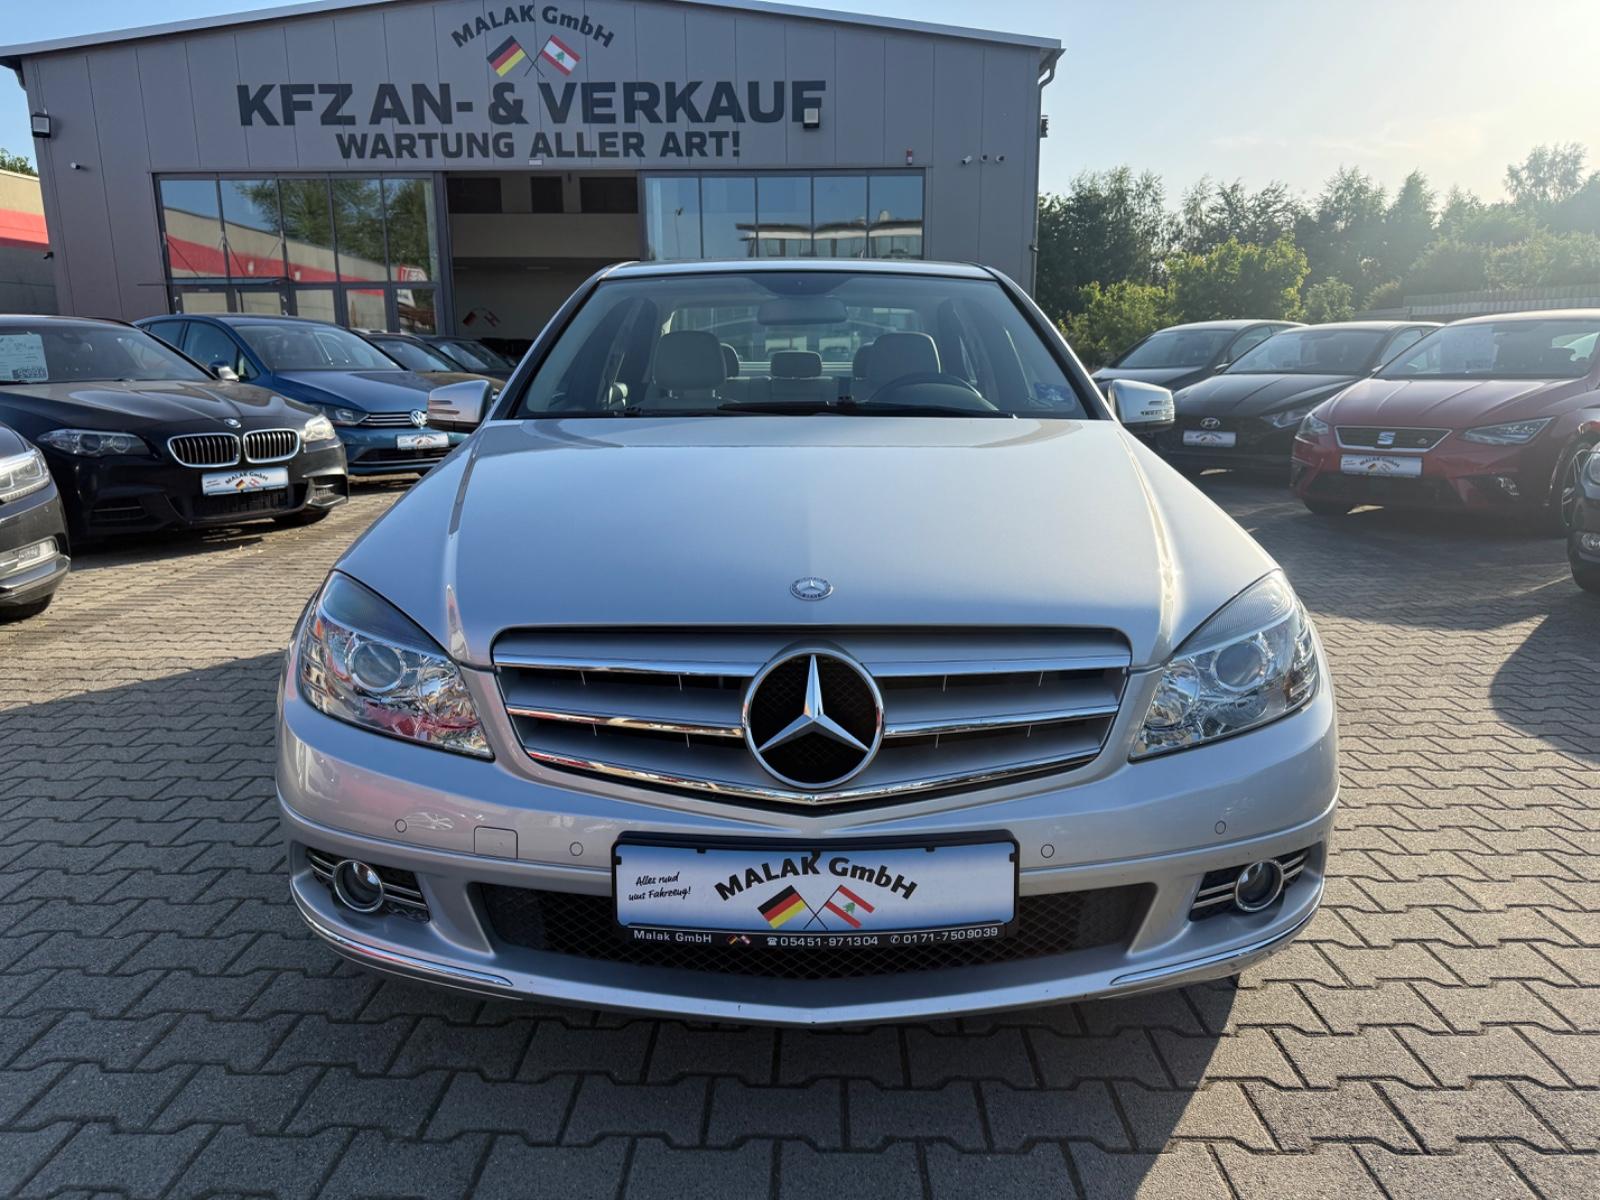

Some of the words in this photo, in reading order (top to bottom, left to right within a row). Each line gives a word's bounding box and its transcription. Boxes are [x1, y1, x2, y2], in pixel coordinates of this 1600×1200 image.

[451, 5, 535, 48] MALAK
[542, 6, 614, 48] GmbH
[236, 83, 355, 126] KFZ
[369, 83, 474, 125] AN-
[488, 82, 529, 124] &
[538, 80, 827, 124] VERKAUF
[336, 132, 515, 159] WARTUNG
[530, 131, 646, 158] ALLER
[660, 130, 741, 158] ART!
[635, 875, 657, 887] Alles
[658, 871, 680, 884] rund
[648, 885, 692, 900] Fahrzeug!
[714, 855, 820, 901] MALAK
[827, 857, 919, 900] GmbH
[633, 930, 670, 941] Malak
[675, 932, 712, 944] GmbH
[780, 936, 879, 947] 05451-971304
[903, 927, 999, 944] 0171-7509039
